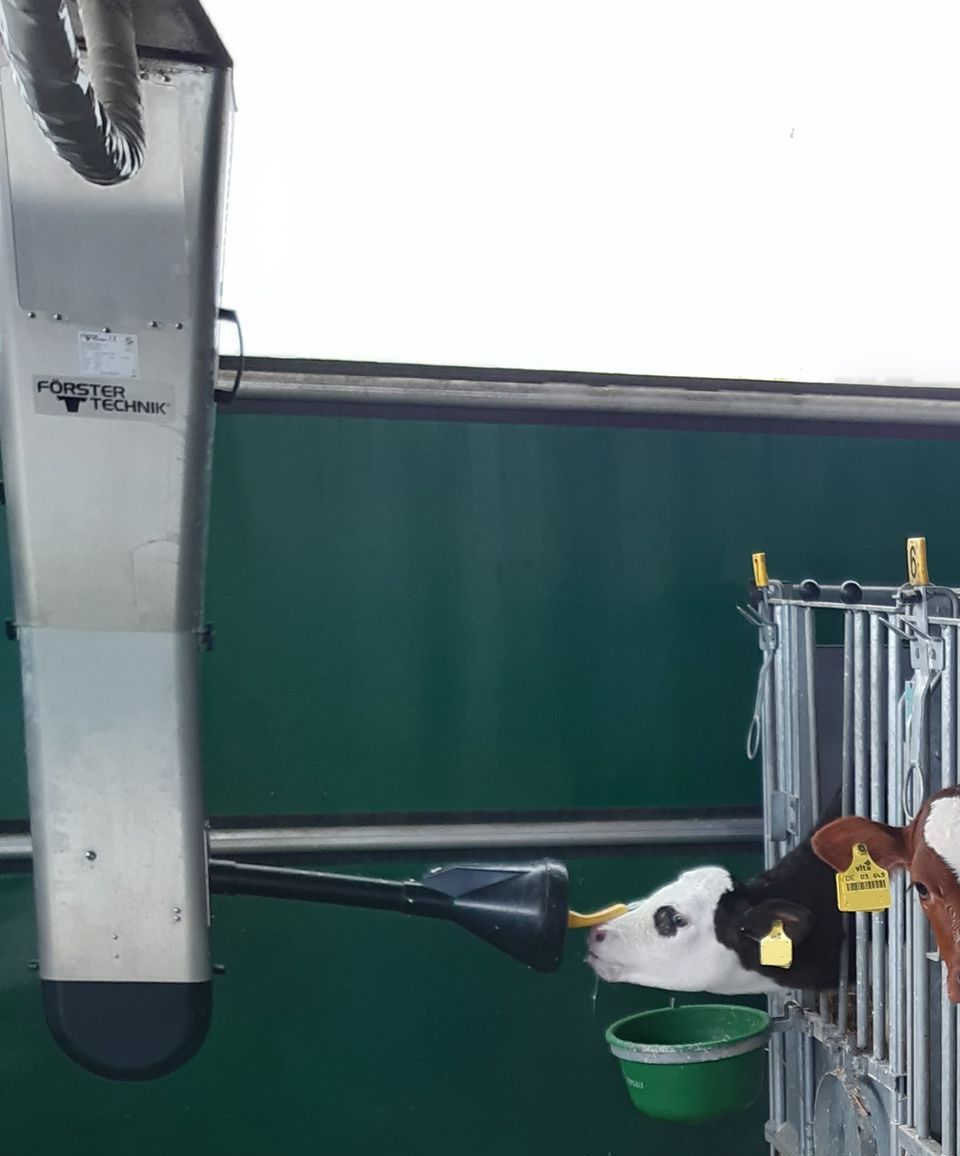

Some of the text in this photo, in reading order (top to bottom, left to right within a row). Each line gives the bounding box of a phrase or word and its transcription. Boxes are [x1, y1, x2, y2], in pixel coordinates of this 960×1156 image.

[37, 378, 126, 398] FÖRSTER
[90, 397, 167, 415] TECHNIK
[909, 544, 917, 578] 6
